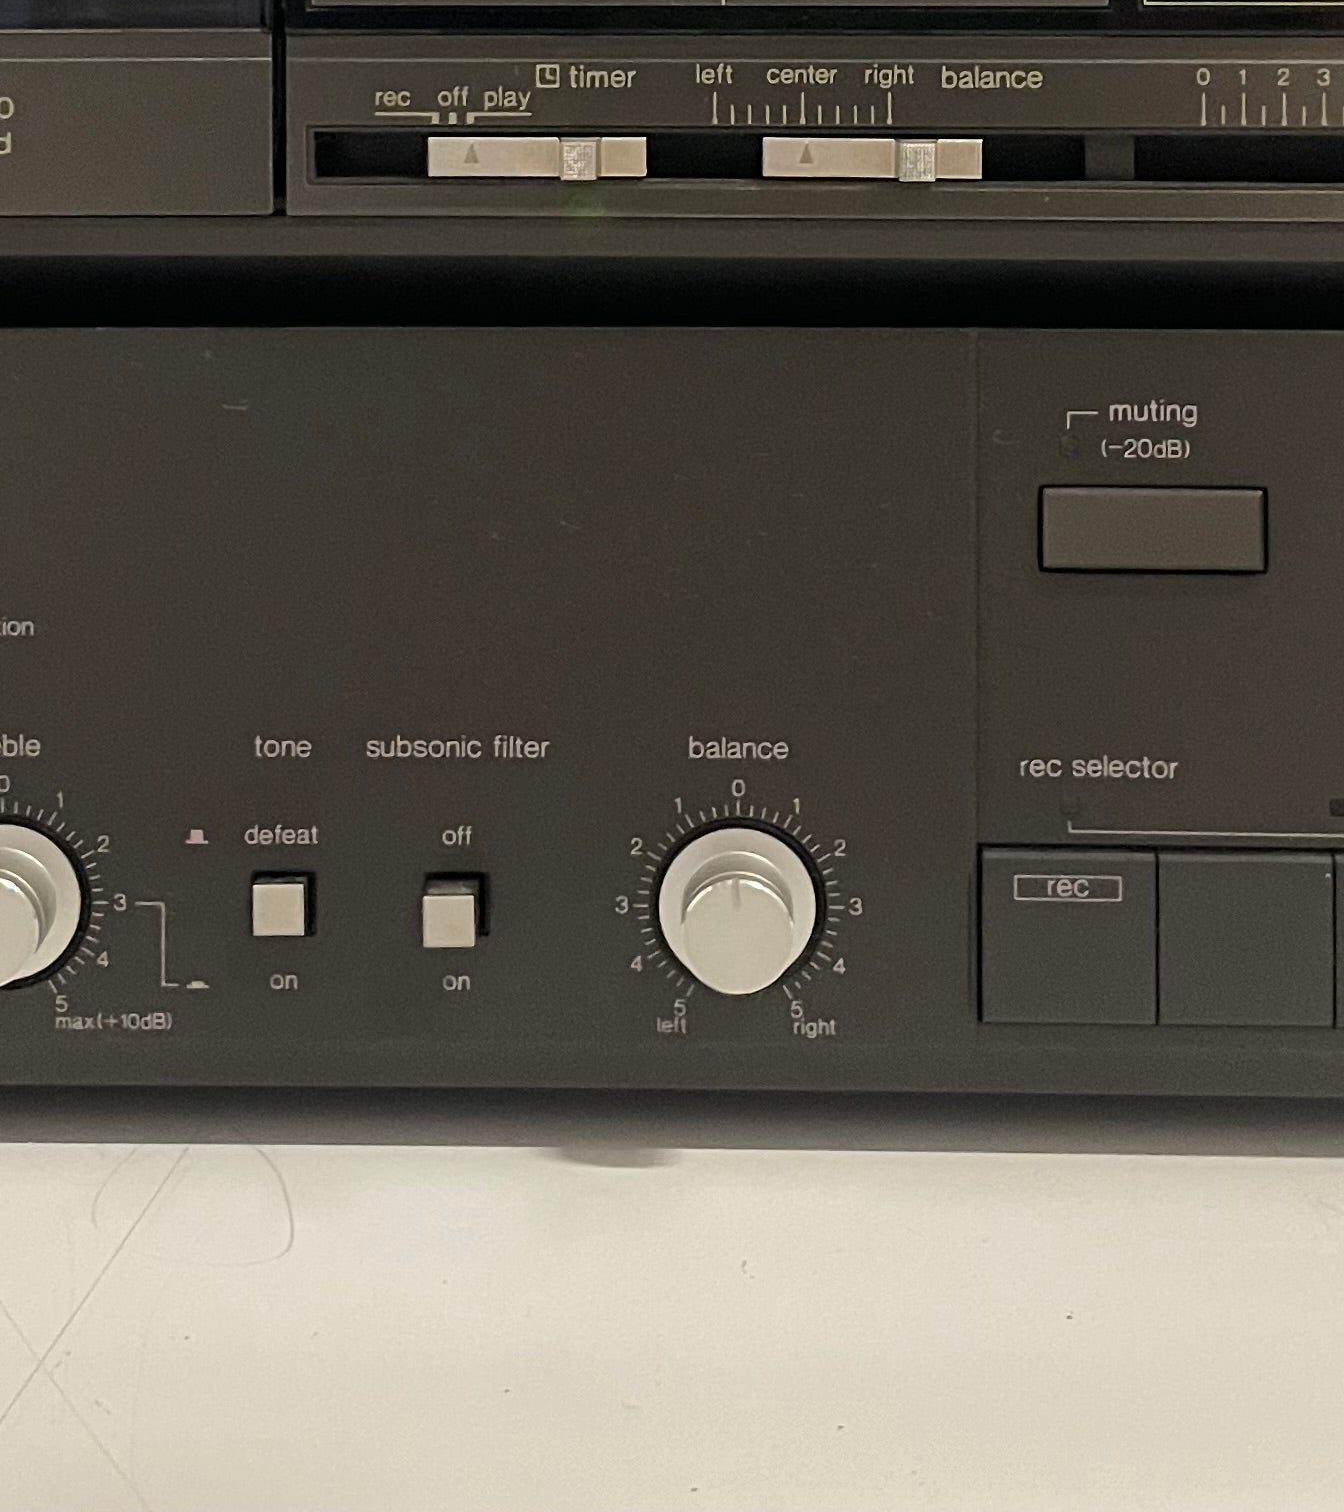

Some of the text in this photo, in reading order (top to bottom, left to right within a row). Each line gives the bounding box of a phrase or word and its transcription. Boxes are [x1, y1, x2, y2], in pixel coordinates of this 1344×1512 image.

[570, 64, 636, 89] timer
[696, 63, 732, 84] left
[766, 64, 838, 84] center
[864, 64, 915, 89] right
[941, 65, 1044, 89] balance
[374, 88, 410, 107] rec
[438, 85, 468, 107] off
[483, 86, 532, 111] play
[1109, 400, 1198, 428] muting
[254, 736, 312, 758] tone
[366, 734, 550, 759] subsonic filter
[688, 736, 790, 760] balance
[1020, 755, 1178, 779] rec selector
[244, 824, 318, 846] defeat
